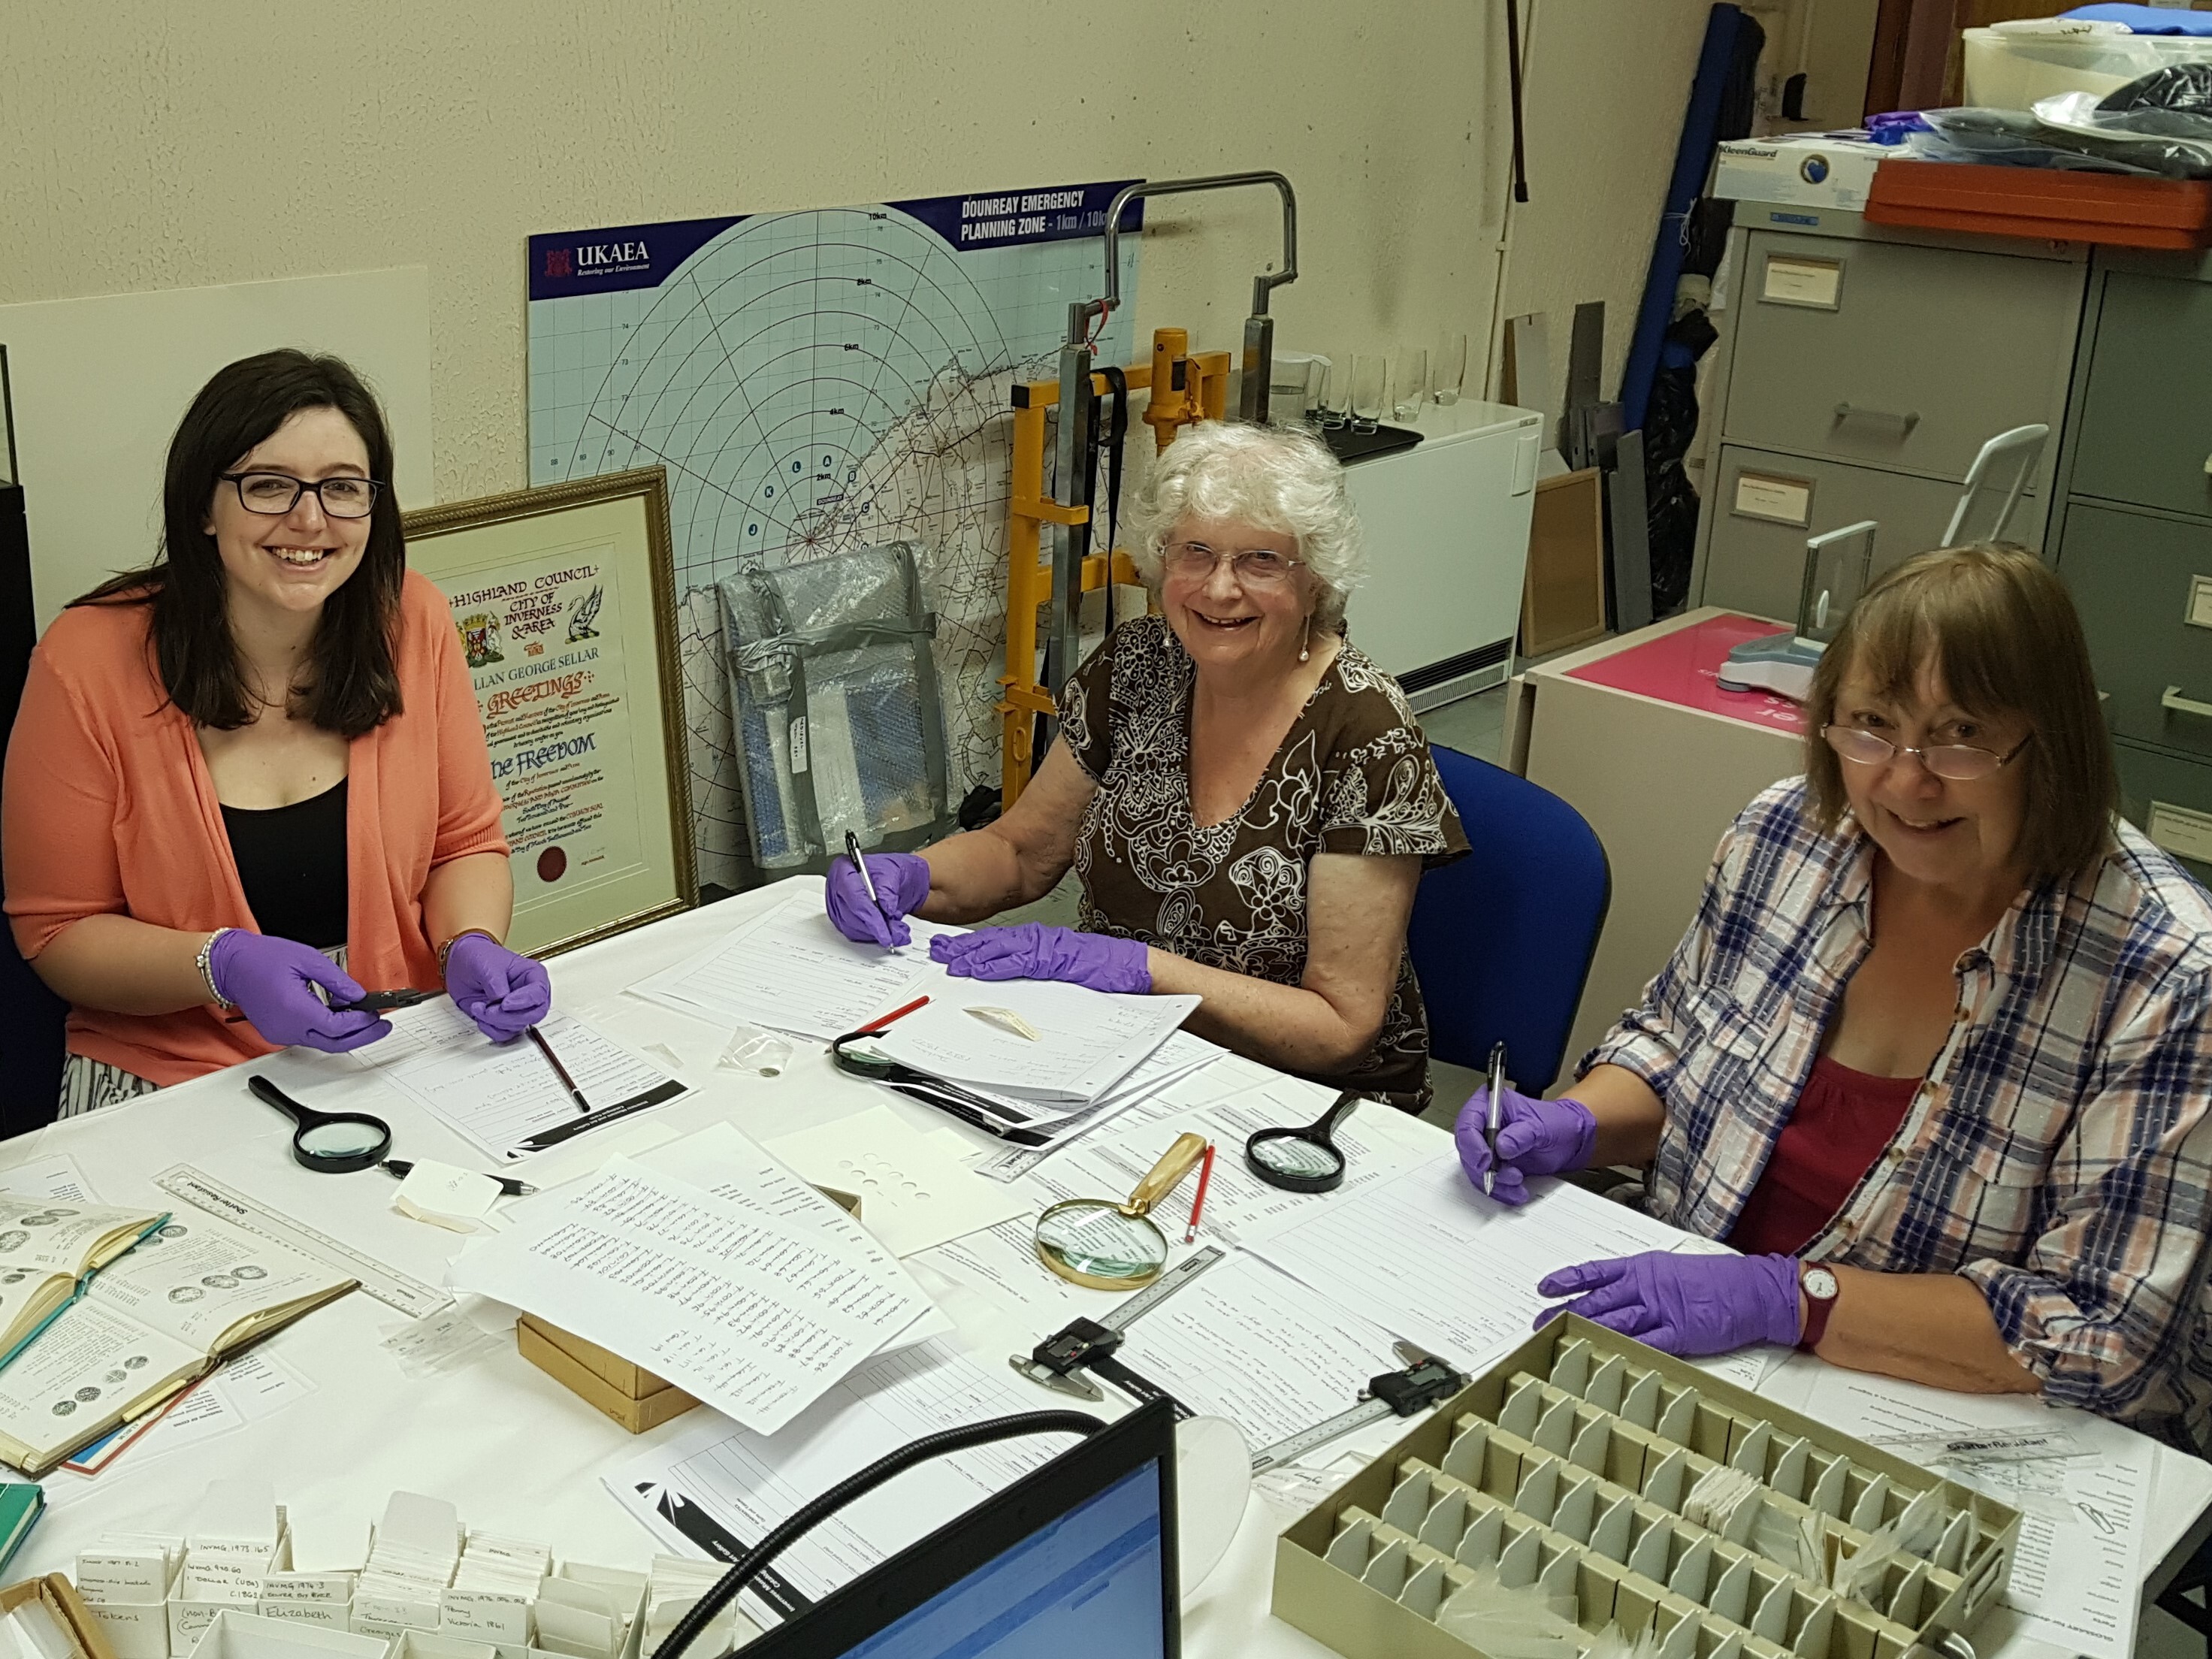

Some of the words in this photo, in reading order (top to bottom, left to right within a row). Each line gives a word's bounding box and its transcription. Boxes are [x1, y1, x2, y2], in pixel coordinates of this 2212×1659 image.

[962, 197, 1019, 219] DOUNREAY
[1021, 190, 1084, 213] EMERGENCY
[869, 213, 887, 221] 10km
[961, 219, 1015, 241] PLANNING
[1017, 216, 1047, 235] ZONE
[1056, 214, 1077, 231] 1km
[1087, 210, 1108, 228] 10k
[576, 241, 649, 266] UKAEA
[577, 267, 603, 276] Restoring
[605, 266, 614, 274] our
[615, 263, 650, 273] Environment
[845, 343, 860, 352] 6km
[816, 473, 831, 482] 2km
[455, 582, 527, 608] HIGHLAND
[534, 565, 596, 589] COUNCIL
[509, 596, 539, 613] CITY
[541, 591, 555, 605] OF
[504, 603, 563, 626] INVERNESS
[473, 671, 505, 690] LLAN
[508, 658, 556, 681] GEORGE
[558, 647, 600, 668] SELLAR
[486, 670, 584, 719] GREETINGS
[517, 733, 597, 776] FREEDOM
[91, 1610, 139, 1621] Tokens
[267, 1606, 333, 1620] Elizabeth
[447, 1617, 482, 1629] Victoria
[487, 1621, 506, 1630] 1861
[2067, 1624, 2114, 1642] GLOSSARY
